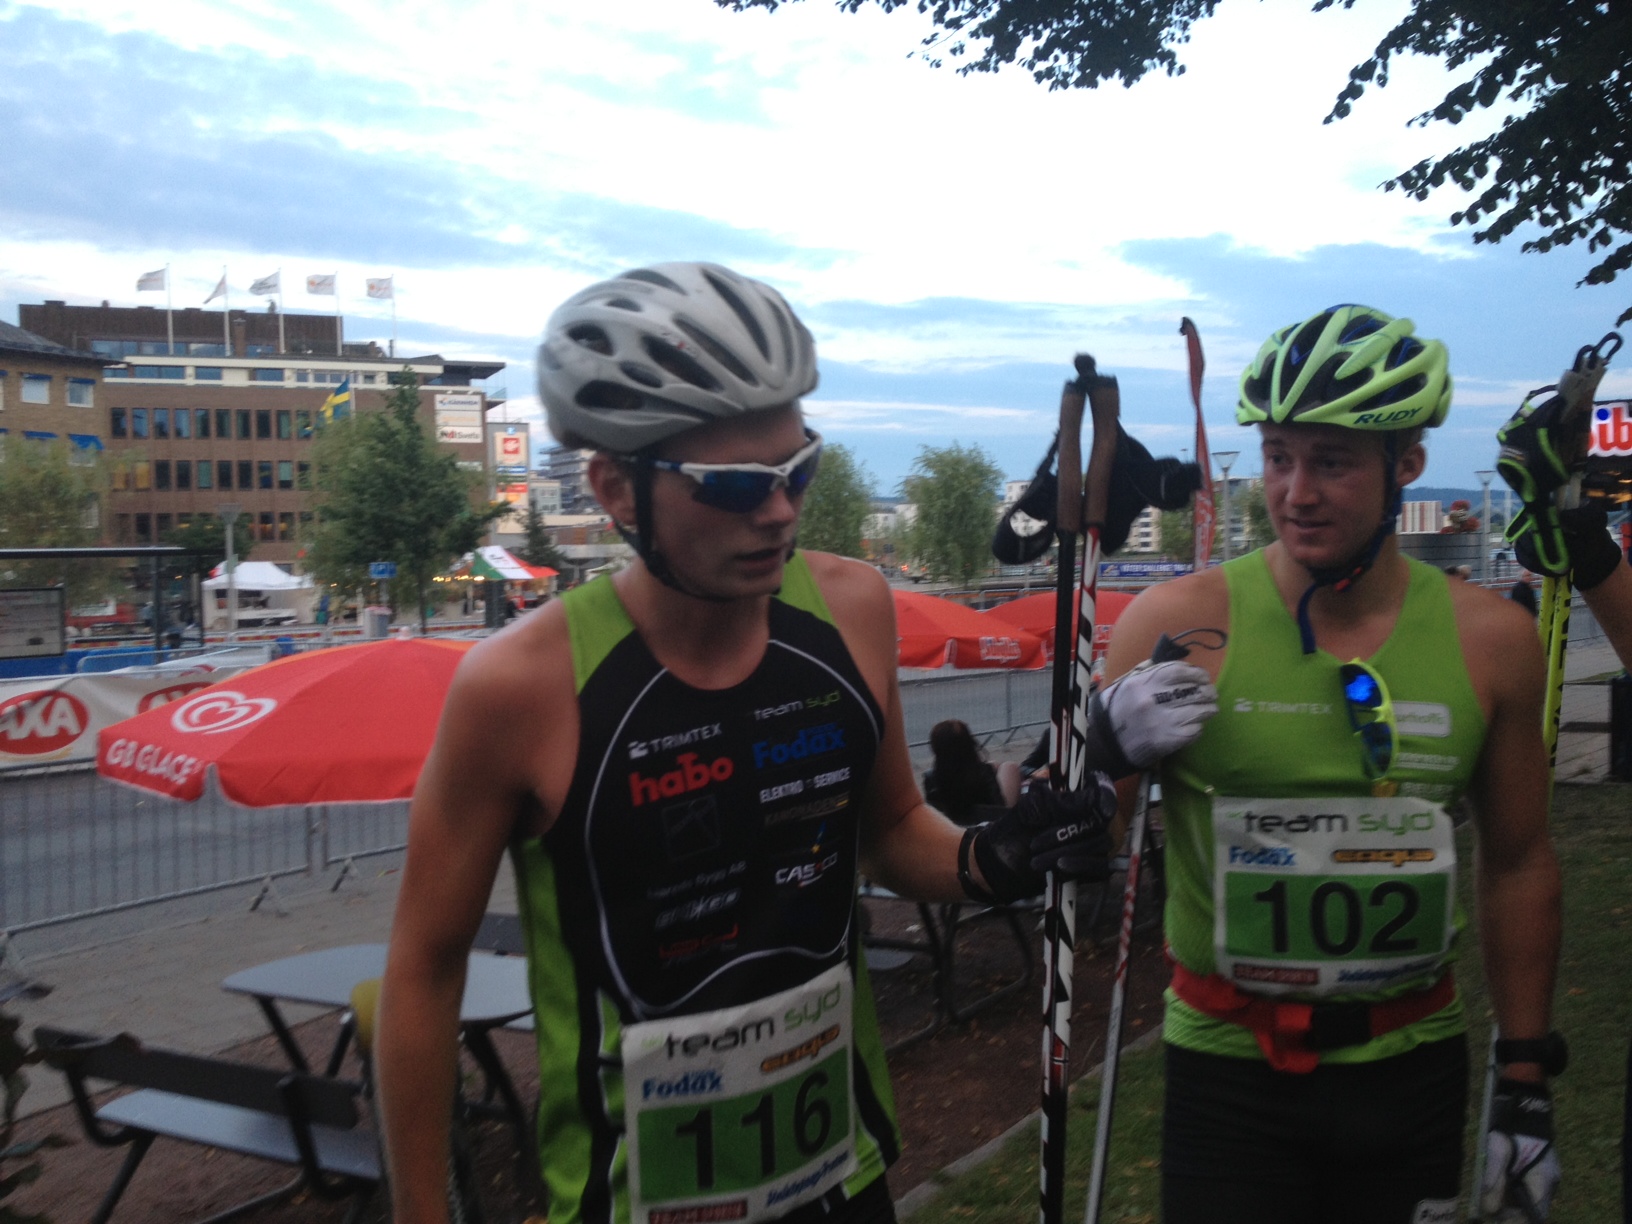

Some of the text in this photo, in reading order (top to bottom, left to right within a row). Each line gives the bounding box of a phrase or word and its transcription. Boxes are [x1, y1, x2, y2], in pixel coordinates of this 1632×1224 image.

[1353, 407, 1423, 424] RUDY
[1588, 407, 1632, 451] ib
[753, 690, 841, 720] team syd
[1257, 700, 1333, 715] TRIMTEX
[648, 722, 723, 753] TRIMTEX
[106, 738, 198, 785] GB GLACE
[628, 751, 735, 808] habo
[812, 766, 852, 788] SERVICE
[1243, 808, 1436, 836] team syd
[1254, 879, 1419, 956] 102
[665, 1016, 776, 1059] team
[783, 984, 841, 1033] syd
[675, 1070, 832, 1190] 116
